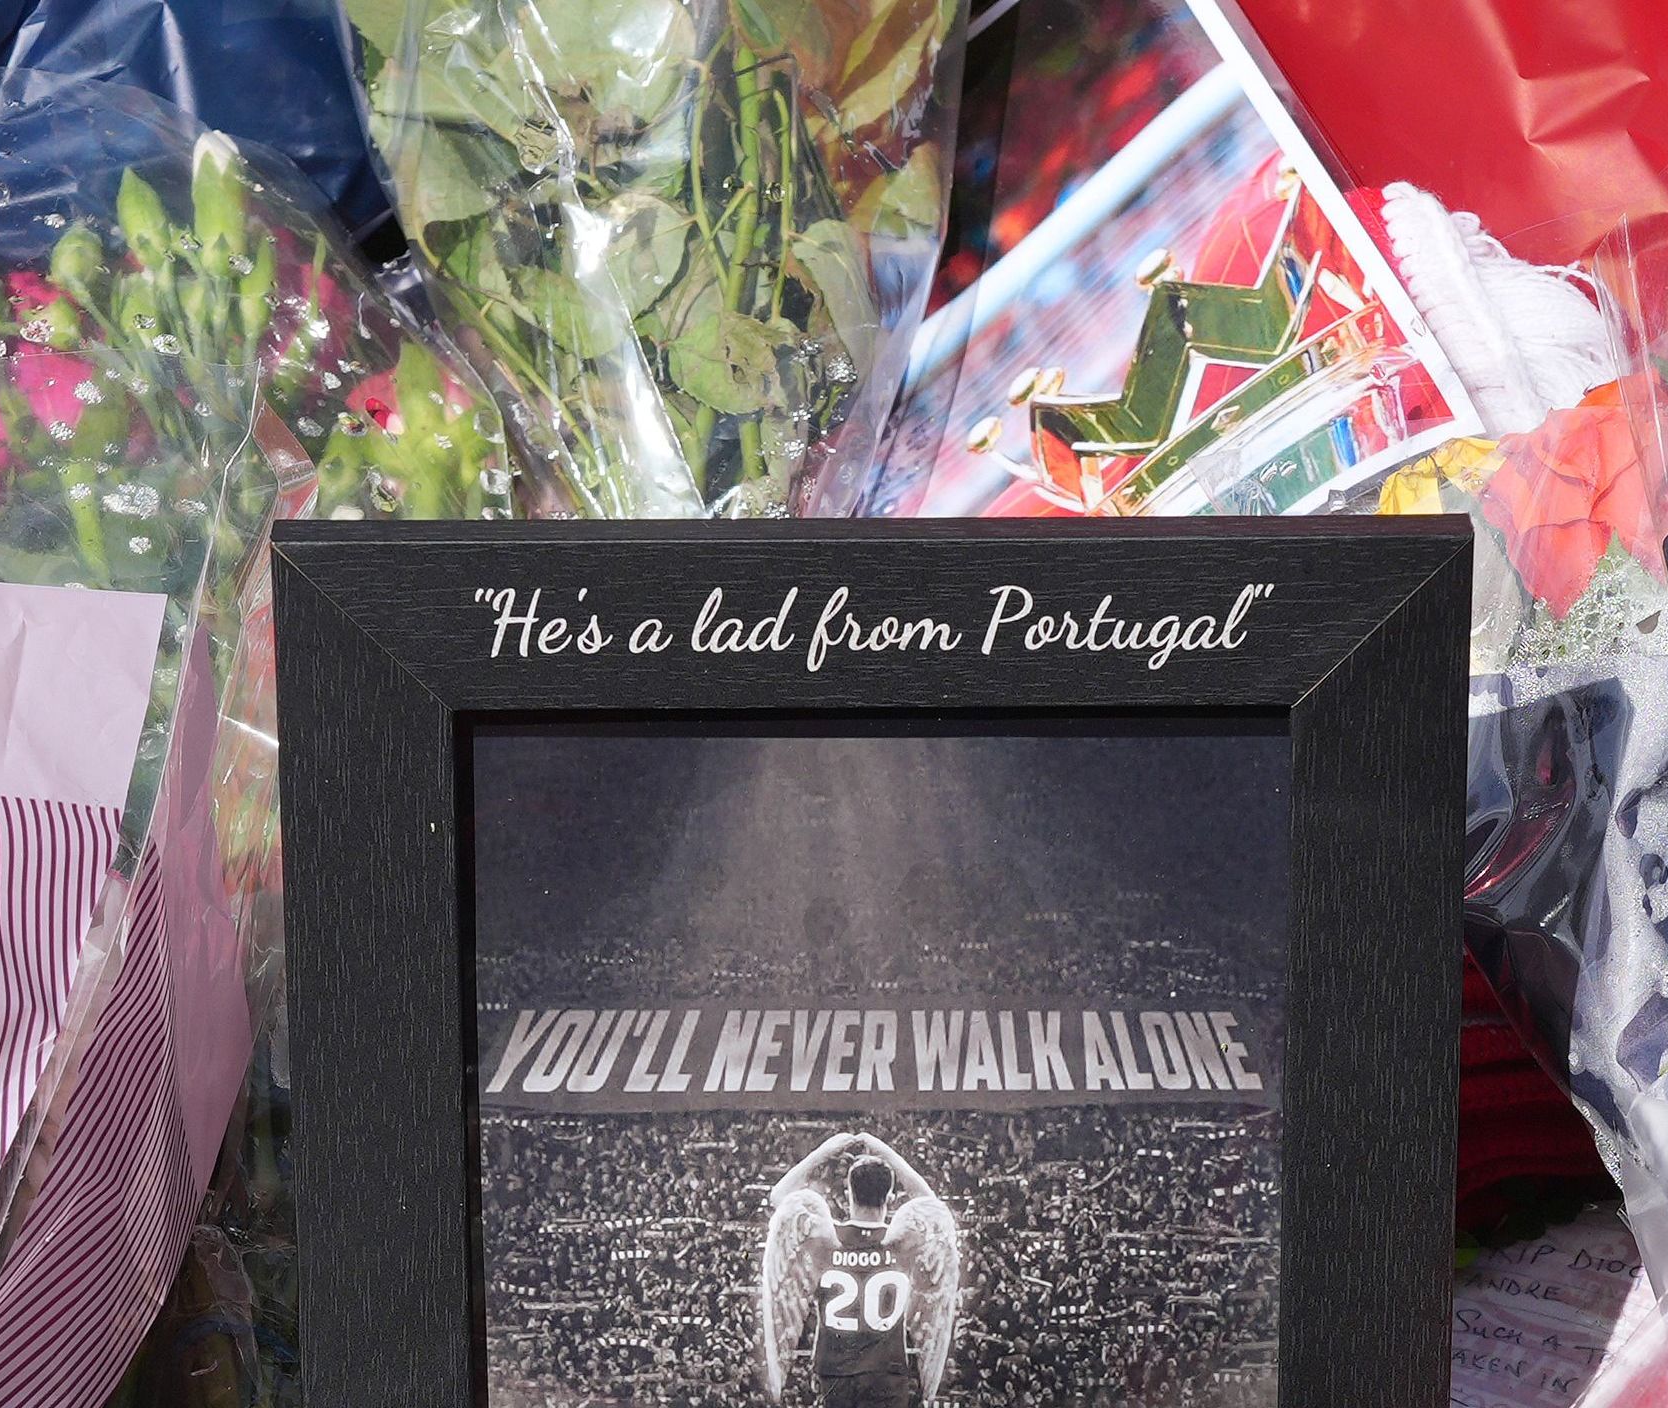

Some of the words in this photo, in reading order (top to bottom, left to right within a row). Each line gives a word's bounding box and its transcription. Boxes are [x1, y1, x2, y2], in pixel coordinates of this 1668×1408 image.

[629, 617, 674, 653] a
[690, 586, 795, 653] lad
[806, 586, 963, 672] from
[980, 583, 1285, 671] Portugal"
[485, 1009, 701, 1093] YOU'LL
[703, 1009, 899, 1092] NEVER
[911, 1010, 1075, 1091] WALK
[1082, 1010, 1263, 1091] ALONE
[832, 1250, 881, 1267] DIOGO
[884, 1250, 897, 1266] J.
[820, 1269, 911, 1332] 20
